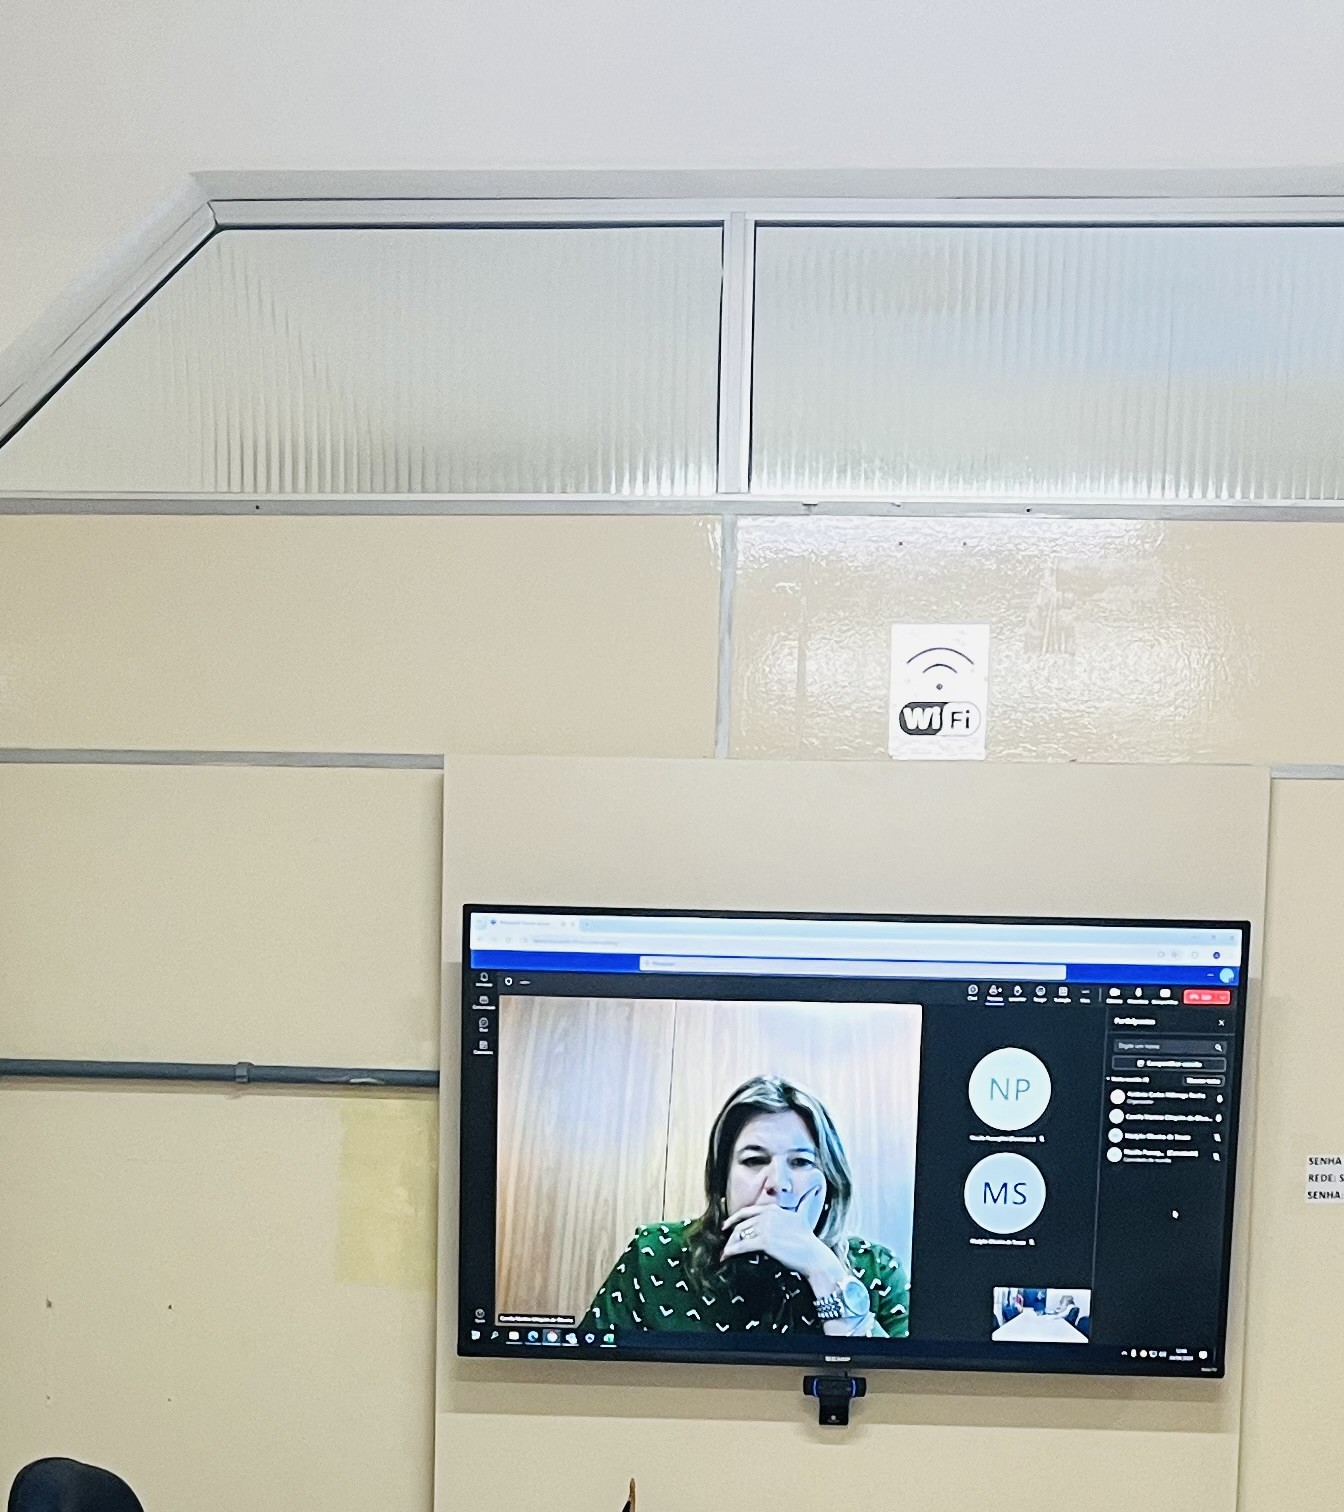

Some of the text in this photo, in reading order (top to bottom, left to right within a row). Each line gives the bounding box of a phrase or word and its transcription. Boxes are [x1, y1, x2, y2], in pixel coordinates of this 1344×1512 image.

[990, 1077, 1030, 1101] NP
[1308, 1157, 1342, 1166] SENHA
[983, 1181, 1027, 1205] MS
